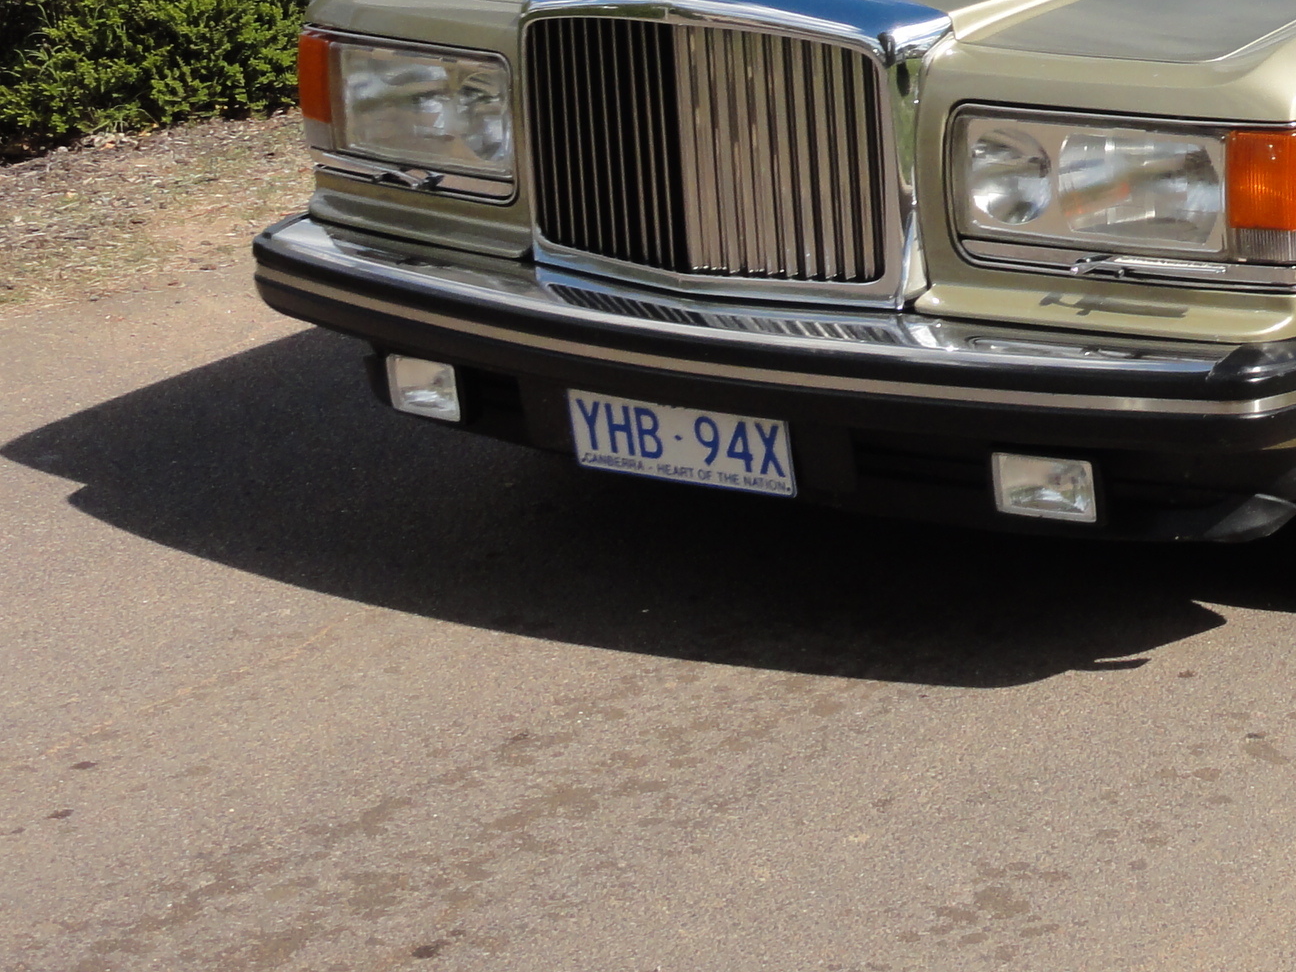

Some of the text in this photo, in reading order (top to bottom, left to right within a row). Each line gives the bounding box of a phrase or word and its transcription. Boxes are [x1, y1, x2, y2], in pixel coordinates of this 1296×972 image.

[575, 398, 663, 459] YHB
[693, 416, 786, 478] 94X
[584, 453, 645, 471] CANBERRA
[656, 464, 694, 478] HEART
[697, 469, 713, 481] OF
[717, 471, 740, 484] THE
[743, 475, 786, 492] NATION
